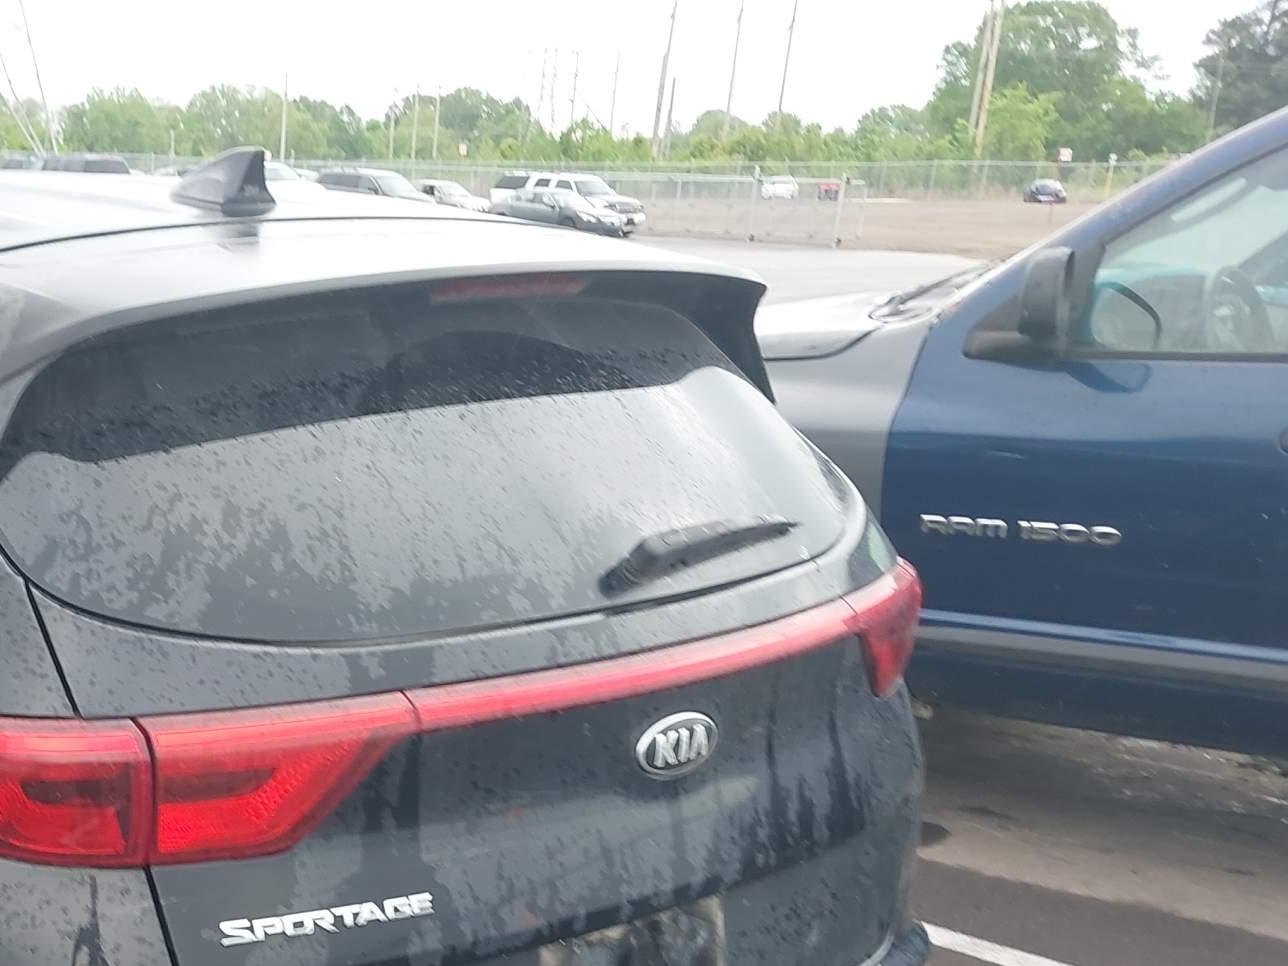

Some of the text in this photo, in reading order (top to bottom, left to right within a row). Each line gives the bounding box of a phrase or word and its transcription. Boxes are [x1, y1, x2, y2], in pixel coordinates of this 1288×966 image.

[919, 513, 1123, 546] RAM 1500
[653, 723, 709, 768] KIA
[218, 892, 435, 948] SPORTAGE
